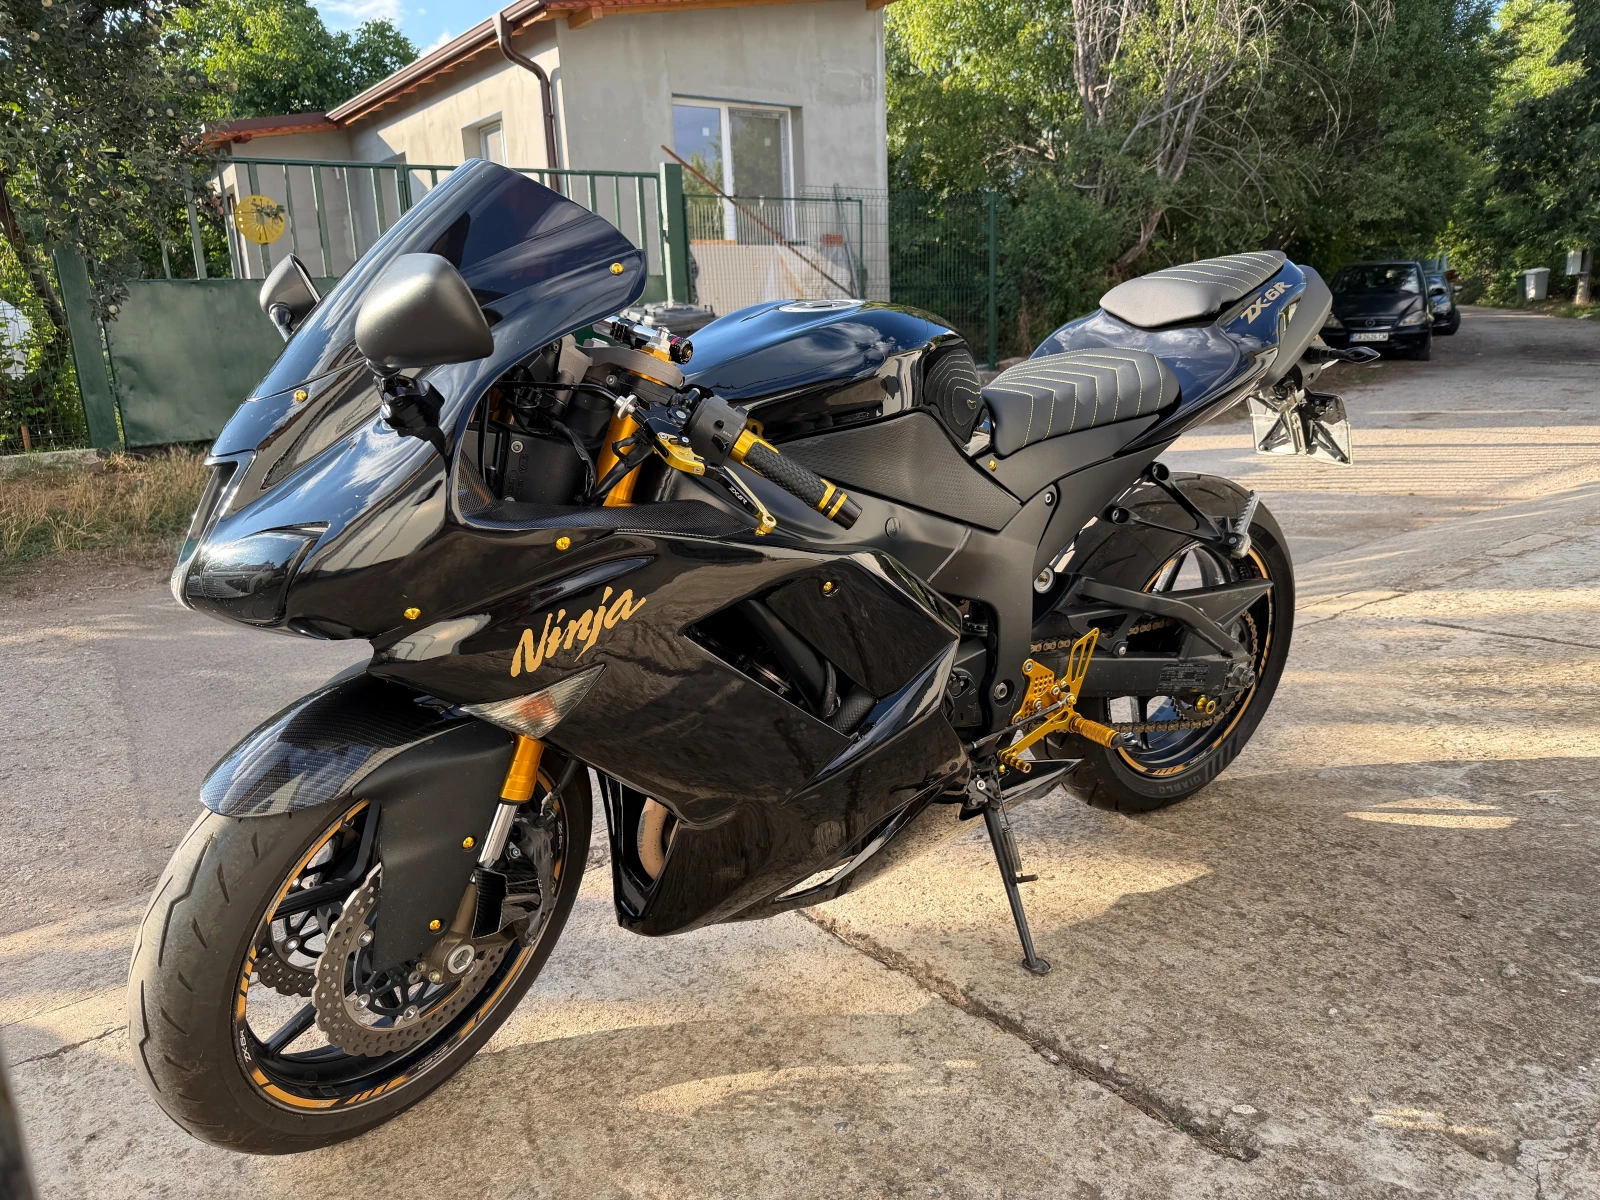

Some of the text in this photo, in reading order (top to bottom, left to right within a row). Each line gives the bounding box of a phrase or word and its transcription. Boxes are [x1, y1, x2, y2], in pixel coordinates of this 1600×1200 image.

[1240, 281, 1293, 324] ZX-6R
[510, 586, 647, 677] Ninja
[1158, 775, 1201, 794] DIABLO
